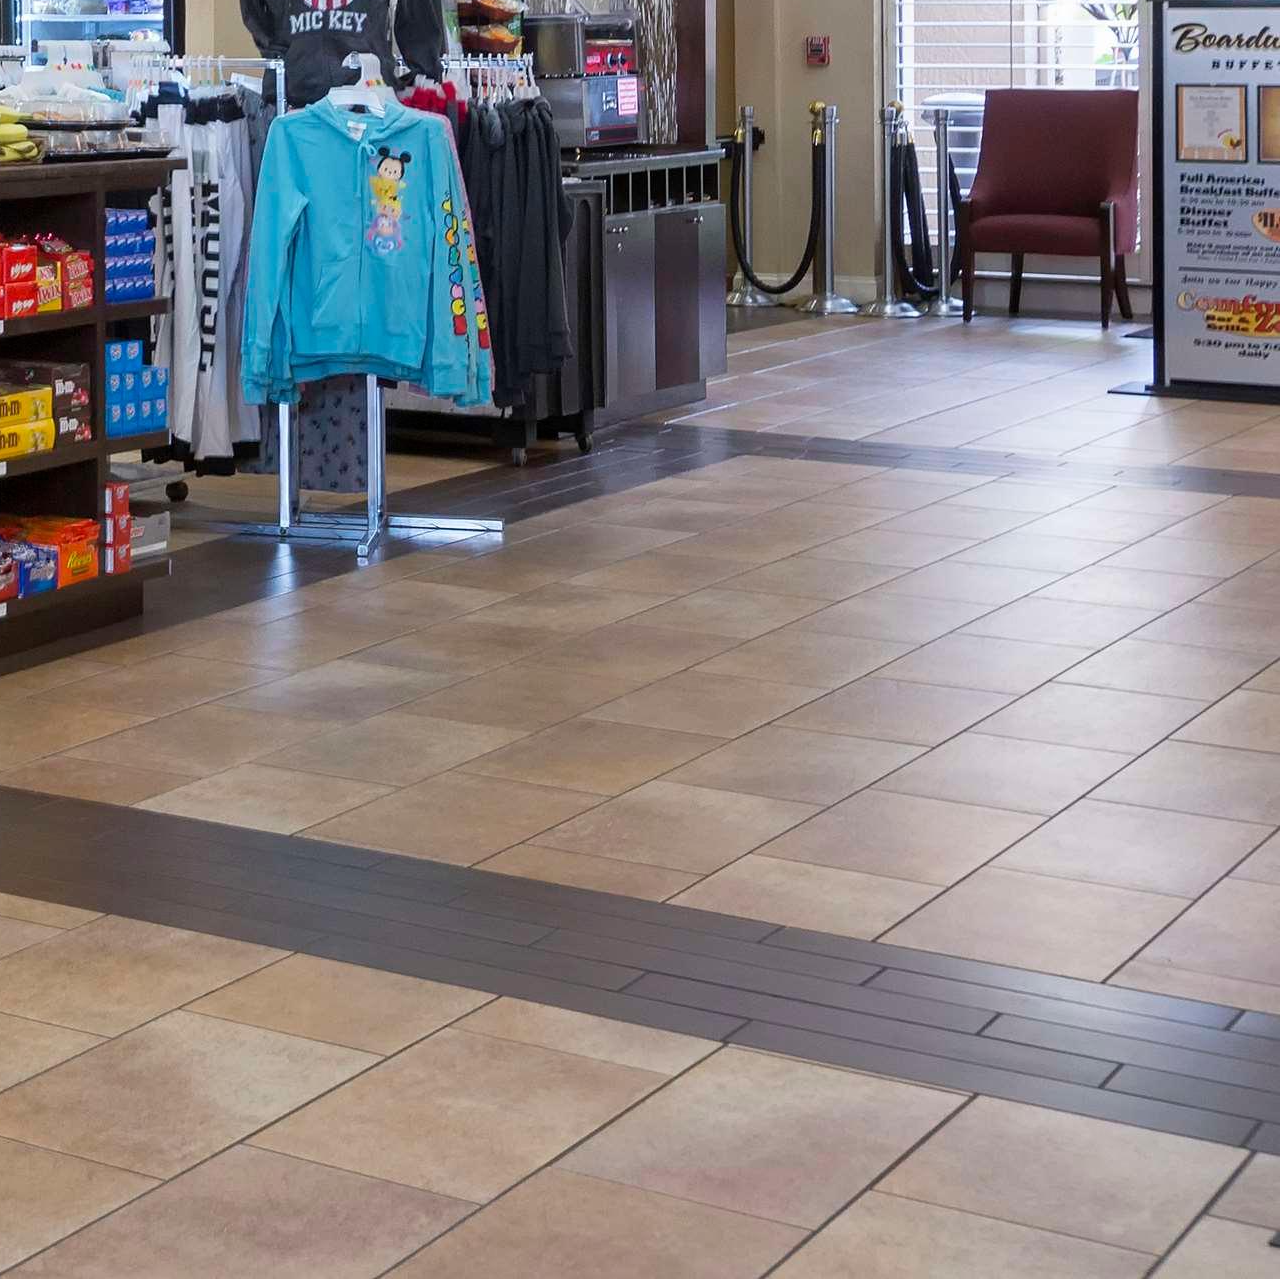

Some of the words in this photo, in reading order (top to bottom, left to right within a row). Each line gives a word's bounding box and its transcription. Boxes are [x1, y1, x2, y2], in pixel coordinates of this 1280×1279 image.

[1179, 173, 1203, 184] Full
[1179, 206, 1234, 217] Dinner
[1179, 218, 1230, 228] Buffet
